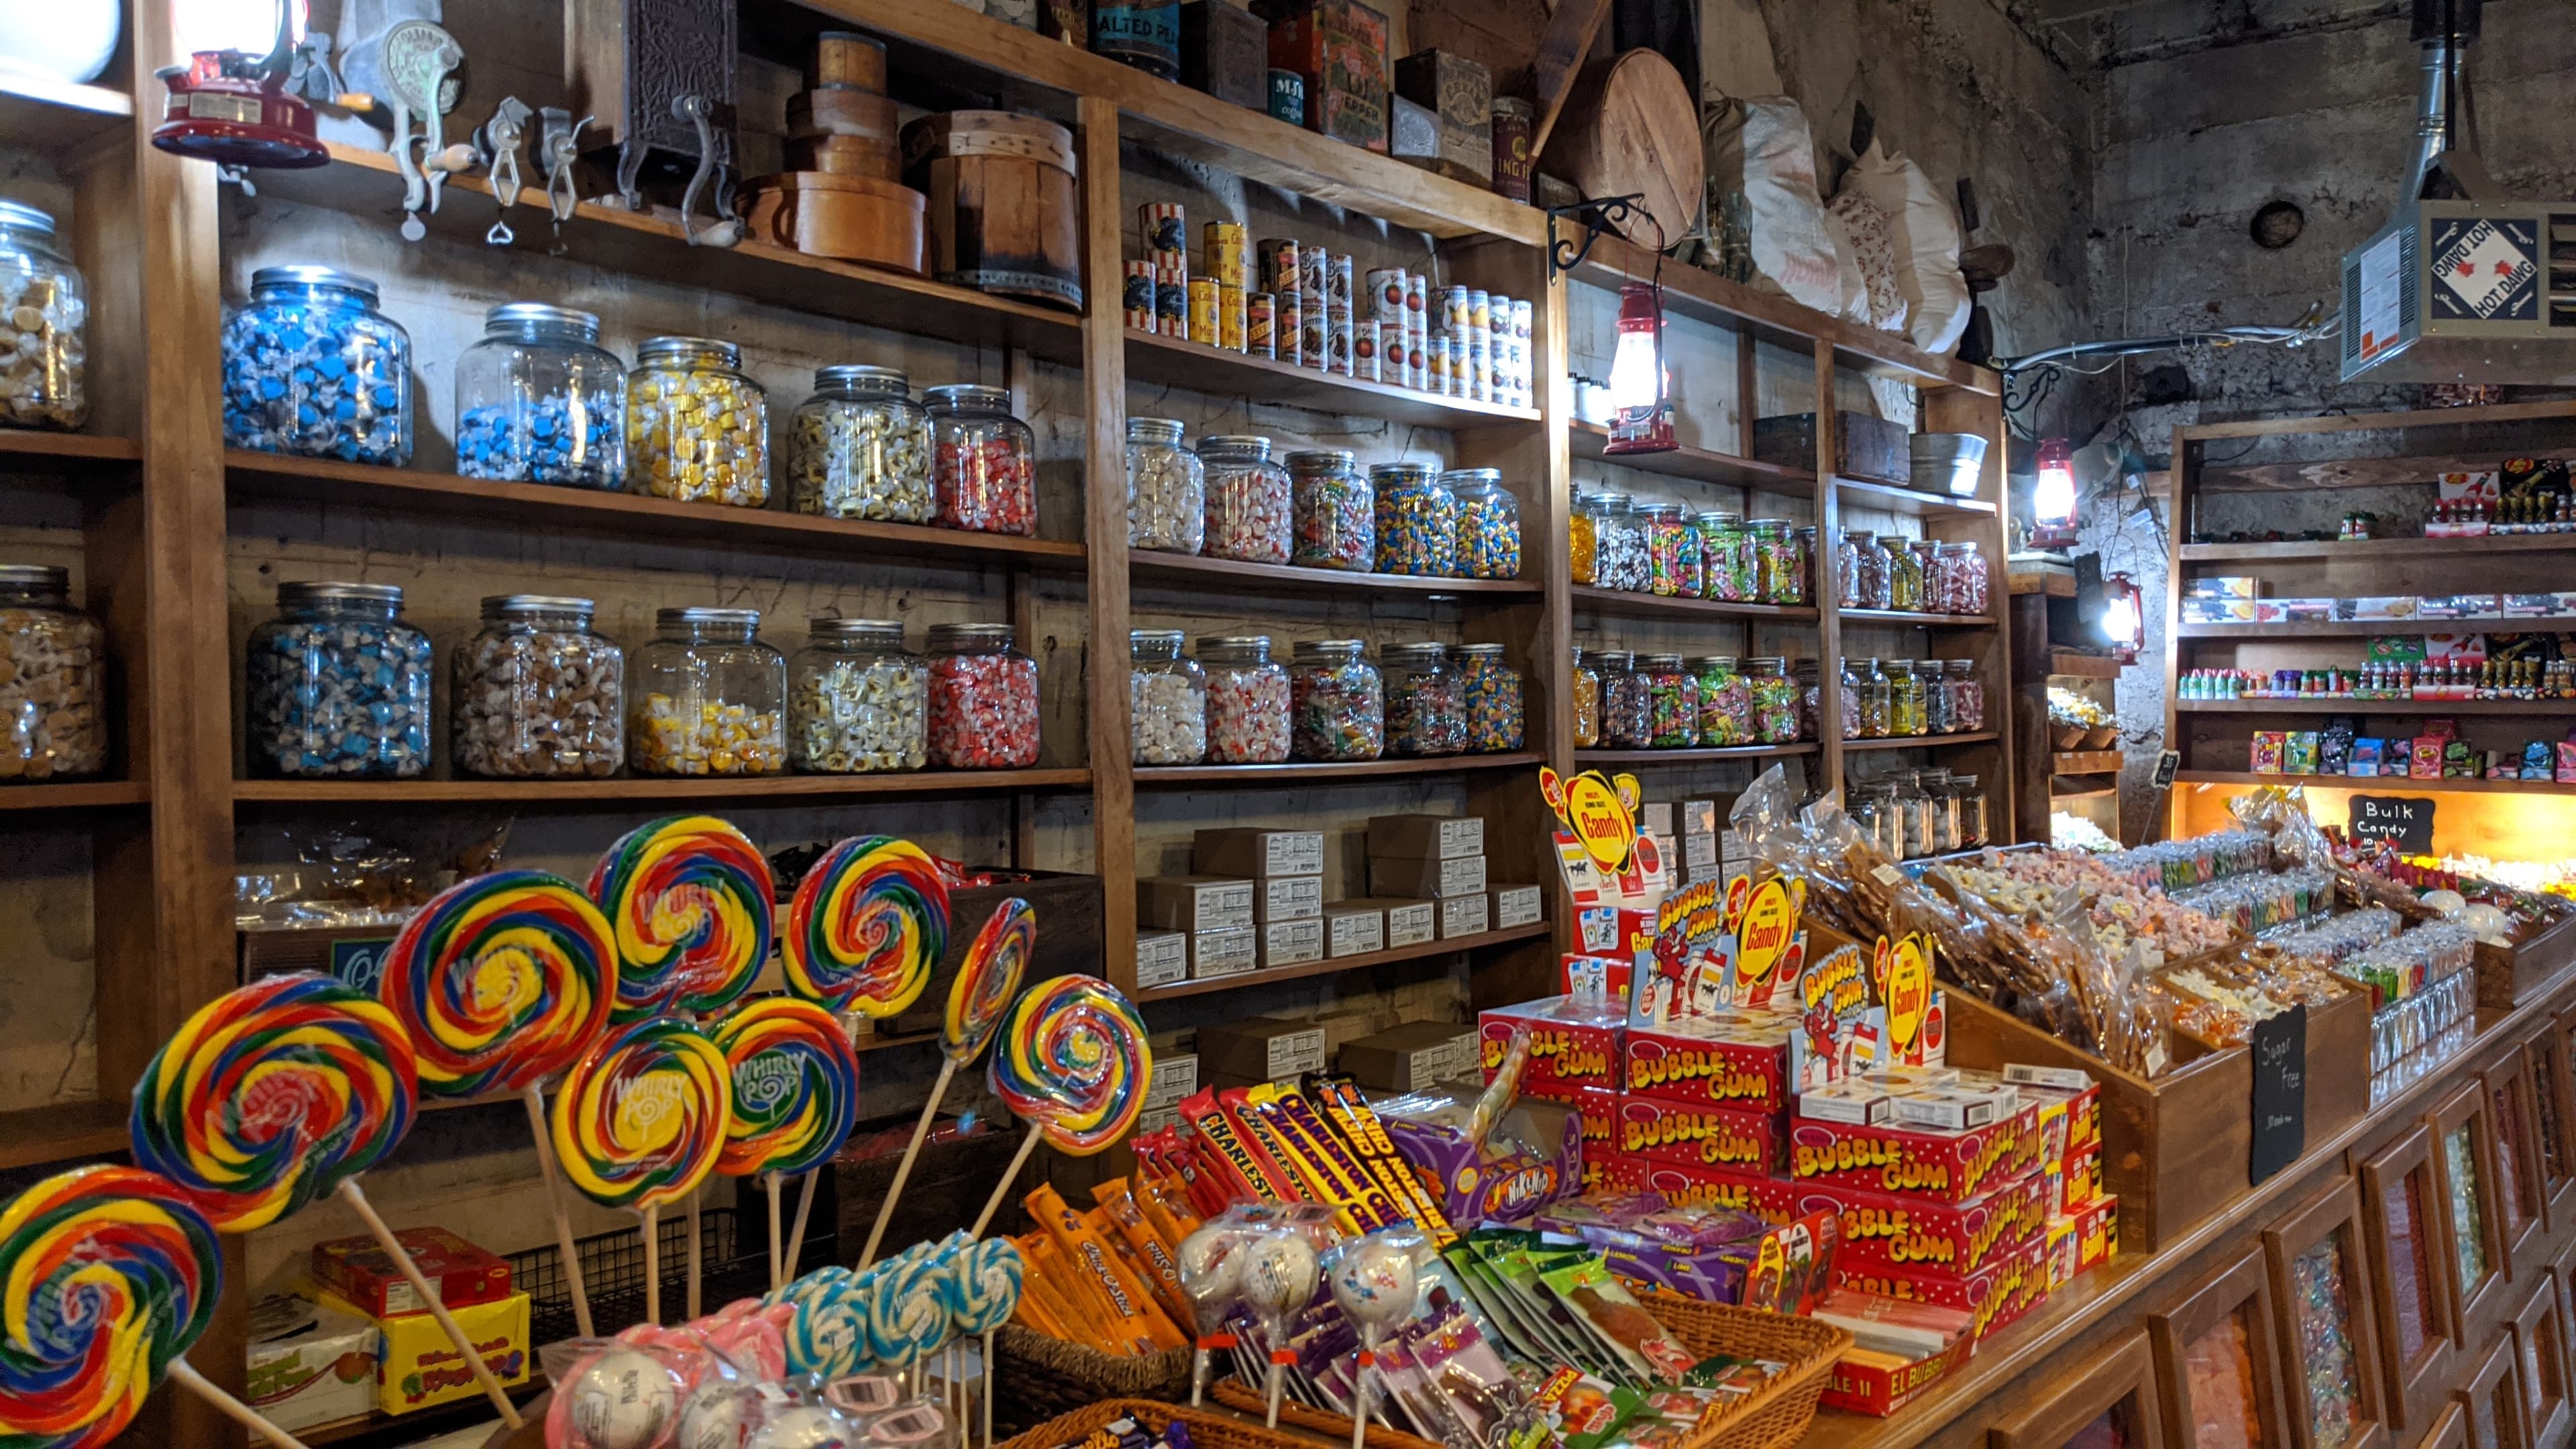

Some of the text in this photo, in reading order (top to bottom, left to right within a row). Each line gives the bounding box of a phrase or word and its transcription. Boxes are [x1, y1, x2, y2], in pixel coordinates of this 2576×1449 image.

[1493, 158, 1519, 177] ING
[2434, 221, 2494, 277] HOT DAWG
[2474, 260, 2535, 317] HOT DAWG
[1581, 810, 1625, 845] Candy
[2365, 801, 2414, 820] Bulk
[2357, 820, 2408, 839] Candy
[1658, 878, 1717, 934] BUBBLE
[1685, 908, 1719, 941] GUM
[1746, 918, 1783, 955] Candy
[1803, 947, 1858, 1009] BUBBLE
[1833, 978, 1864, 1016] GUM
[1894, 978, 1921, 1020] Candy
[731, 1051, 808, 1087] WHIRLY
[1553, 1051, 1607, 1078] GUM
[2262, 1036, 2292, 1066] Sugar
[1631, 1051, 1725, 1089] BUBBLE
[1707, 1073, 1768, 1100] GUM
[2281, 1065, 2300, 1090] Free
[615, 1073, 690, 1105] WHIRLY
[745, 1073, 796, 1104] POP
[624, 1095, 674, 1125] POP
[1277, 1093, 1373, 1193] CHARLESTON
[1326, 1107, 1375, 1157] CHEW
[1348, 1106, 1395, 1155] CHEW
[1625, 1114, 1720, 1151] BUBBLE
[1699, 1136, 1761, 1163] GUM
[1796, 1138, 1902, 1177] BUBBLE
[1964, 1119, 2017, 1197] BUBBLE
[2011, 1131, 2039, 1174] GUM
[1881, 1163, 1949, 1191] GUM
[1843, 1208, 1910, 1240] BBLE
[1970, 1188, 2019, 1270] BUBBLE
[2015, 1199, 2044, 1244] GUM
[1888, 1233, 1955, 1263] GUM
[1974, 1255, 2023, 1339] BUBBLE
[2019, 1263, 2047, 1311] GUM
[1542, 1368, 1579, 1403] PIZZA
[1891, 1373, 1906, 1397] EL
